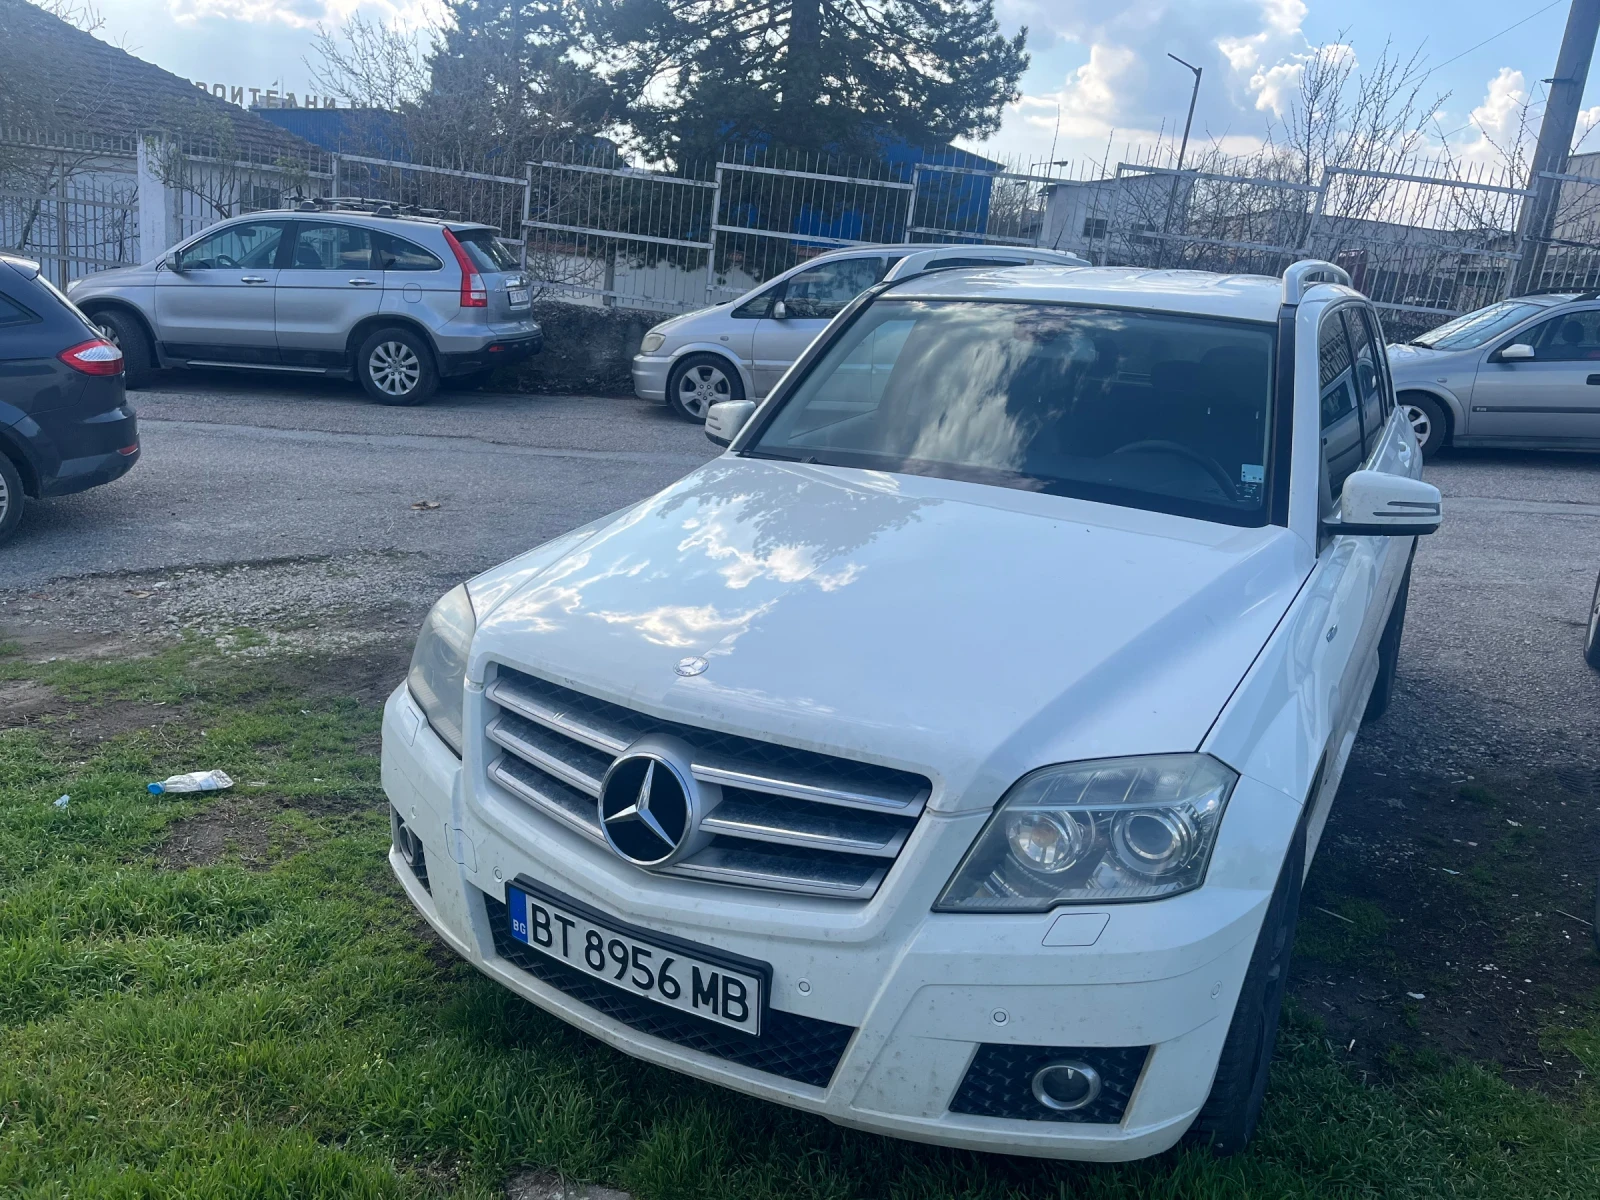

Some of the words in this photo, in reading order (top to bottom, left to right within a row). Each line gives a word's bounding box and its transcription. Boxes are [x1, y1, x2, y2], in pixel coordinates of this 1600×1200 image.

[512, 918, 526, 935] BG
[531, 902, 575, 958] BT
[584, 929, 681, 1000] 8956
[691, 965, 749, 1023] MB
